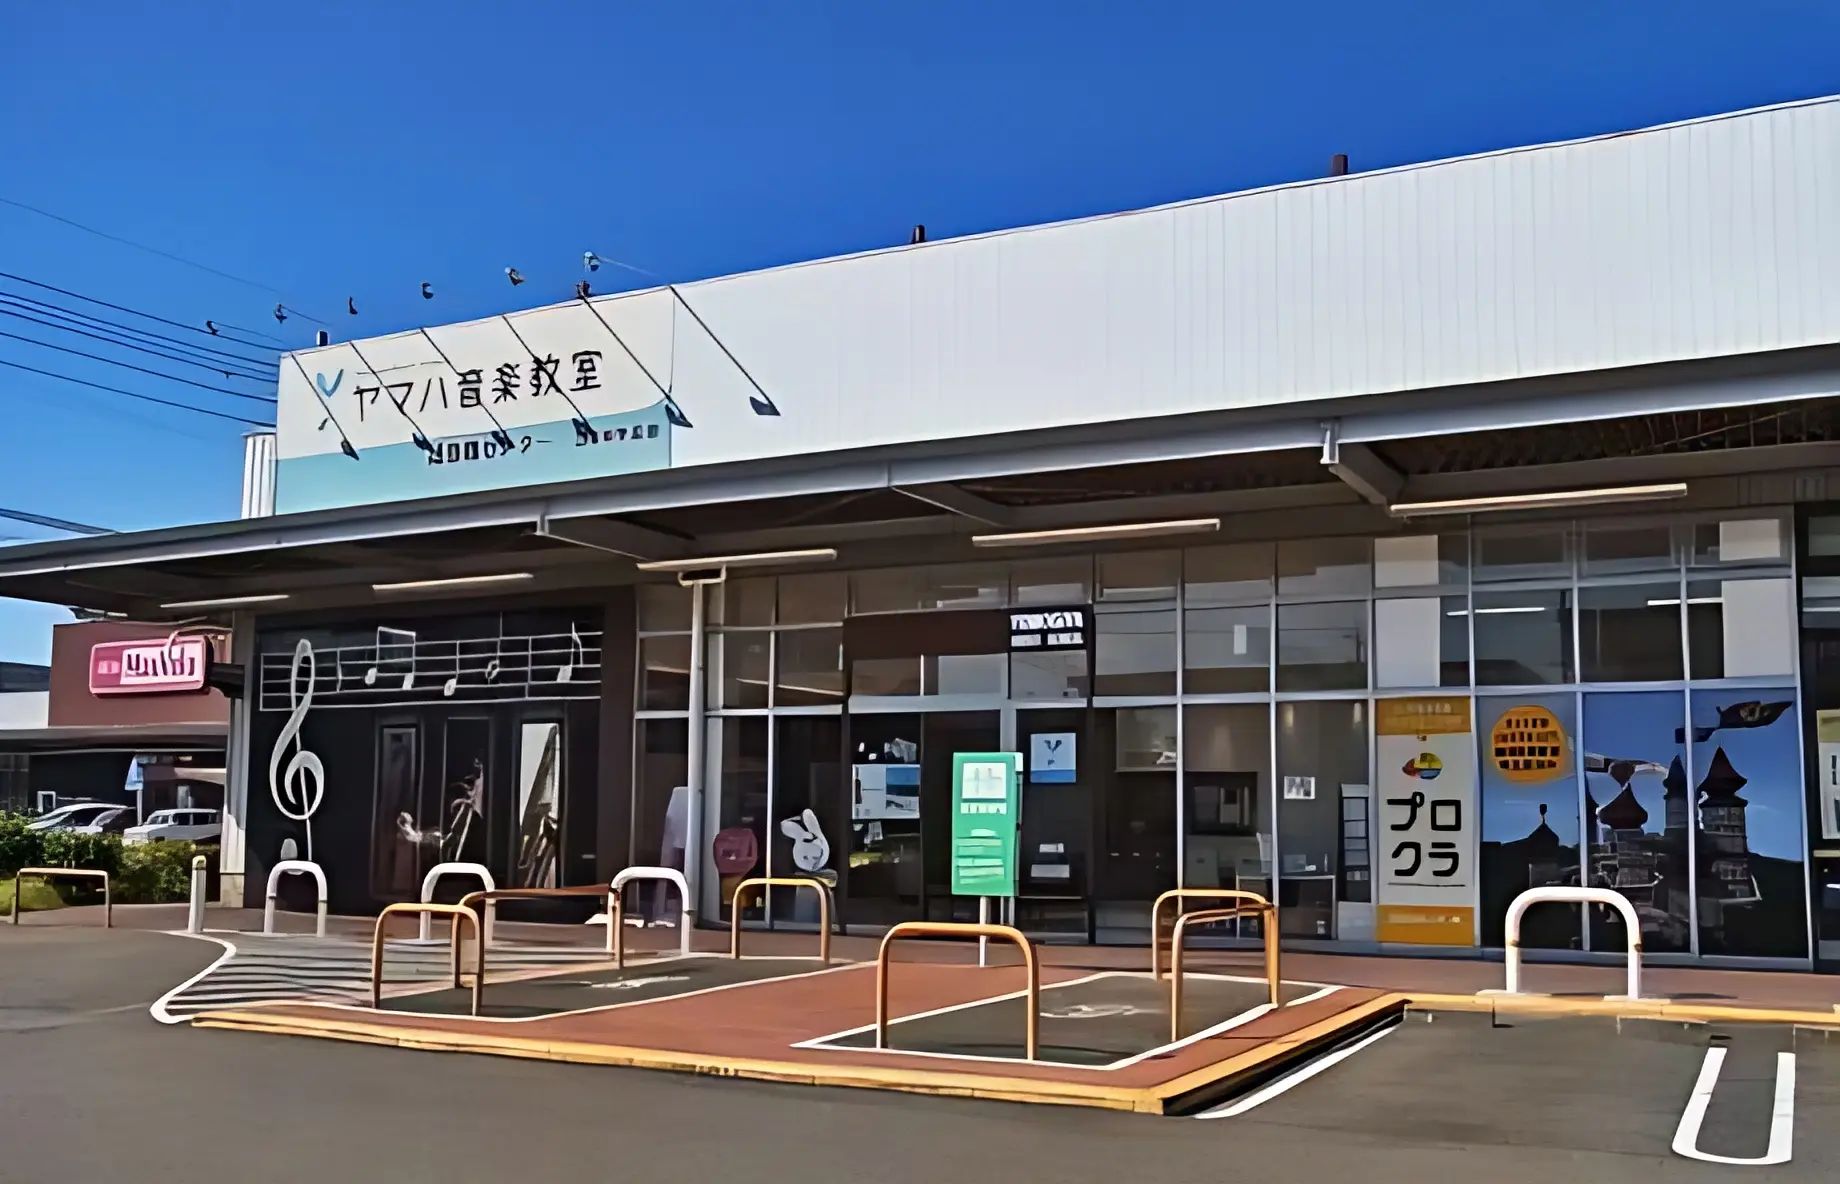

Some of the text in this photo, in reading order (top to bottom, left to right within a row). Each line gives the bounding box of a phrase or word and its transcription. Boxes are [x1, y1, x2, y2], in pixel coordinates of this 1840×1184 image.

[353, 350, 603, 422] ヤマハ音楽教室
[1387, 792, 1461, 831] プロ
[1391, 841, 1459, 877] クラ
